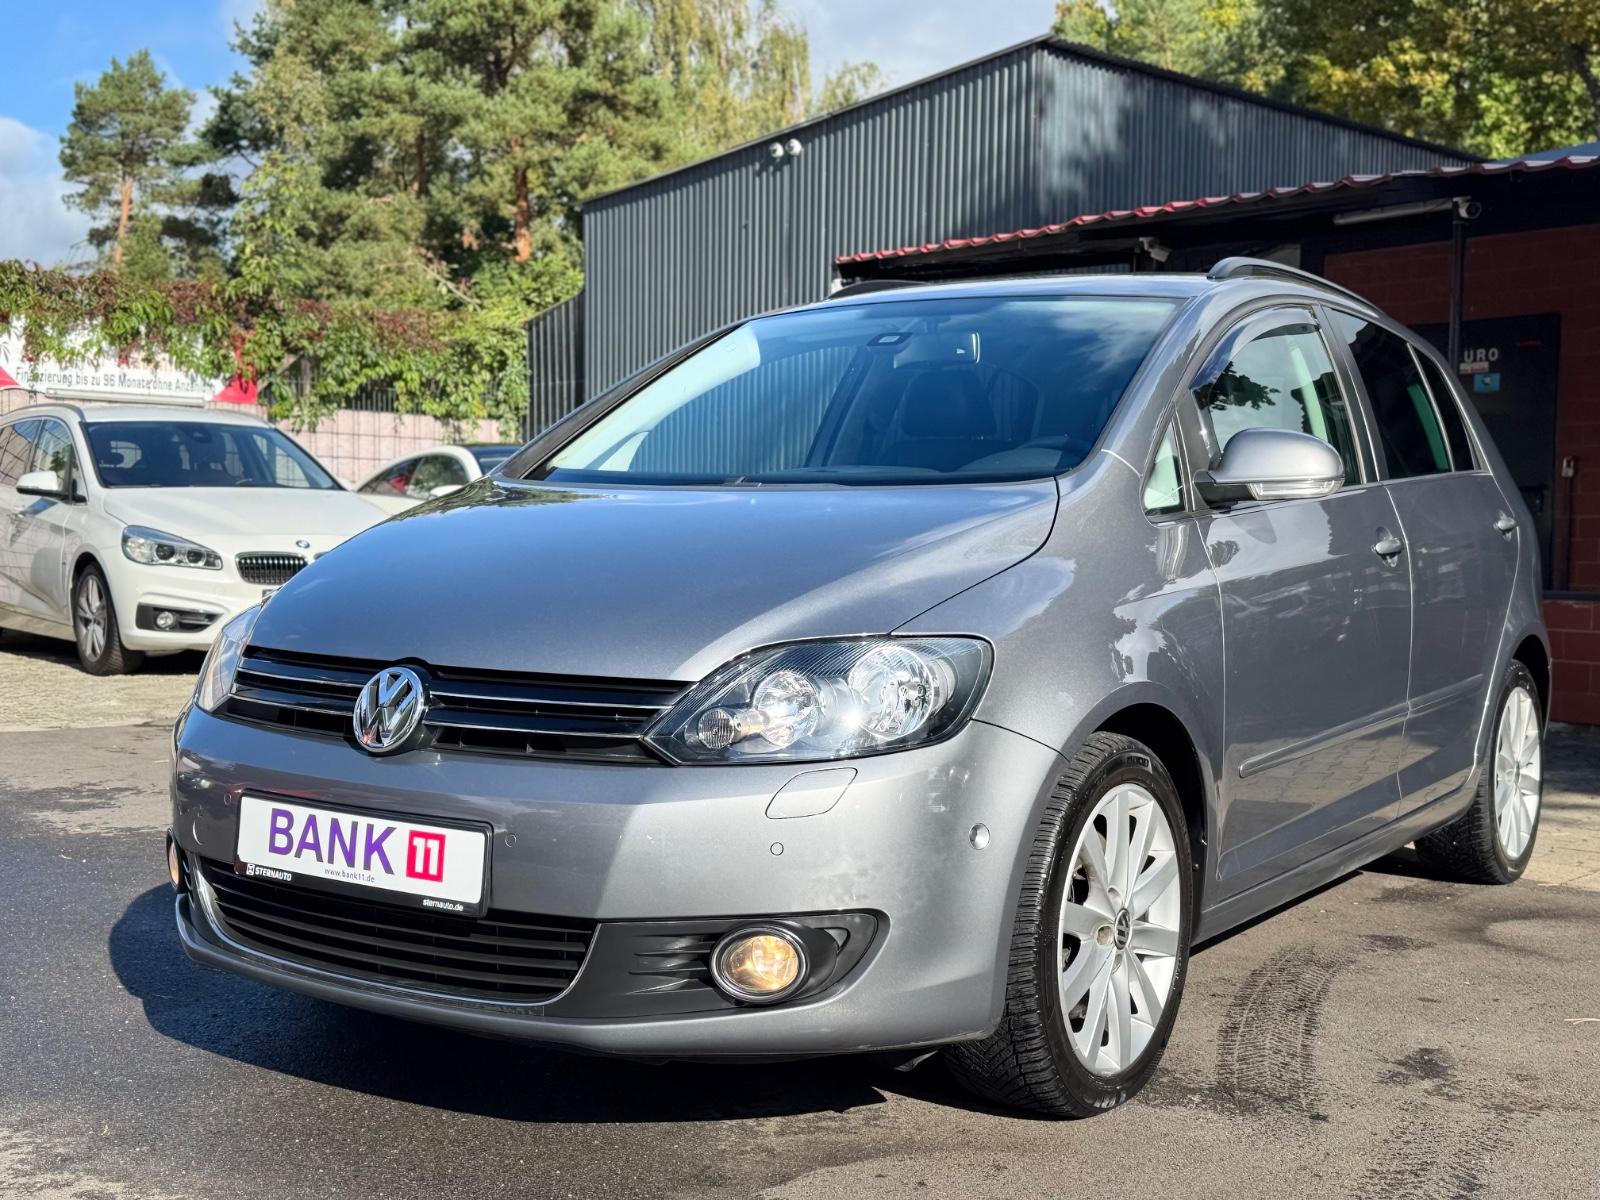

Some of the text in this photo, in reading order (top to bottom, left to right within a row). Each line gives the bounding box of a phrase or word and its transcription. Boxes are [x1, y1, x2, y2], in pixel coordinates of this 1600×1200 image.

[16, 367, 72, 387] Finazierung
[76, 372, 88, 386] bis
[91, 377, 101, 387] zu
[103, 374, 115, 387] 96
[119, 373, 151, 389] Monate
[153, 377, 172, 391] ohne
[355, 669, 420, 750] VW
[268, 808, 440, 876] BANK 11
[255, 866, 292, 881] STERNAUTO
[324, 867, 375, 882] www.bank11.de
[423, 898, 464, 912] sternauto.de
